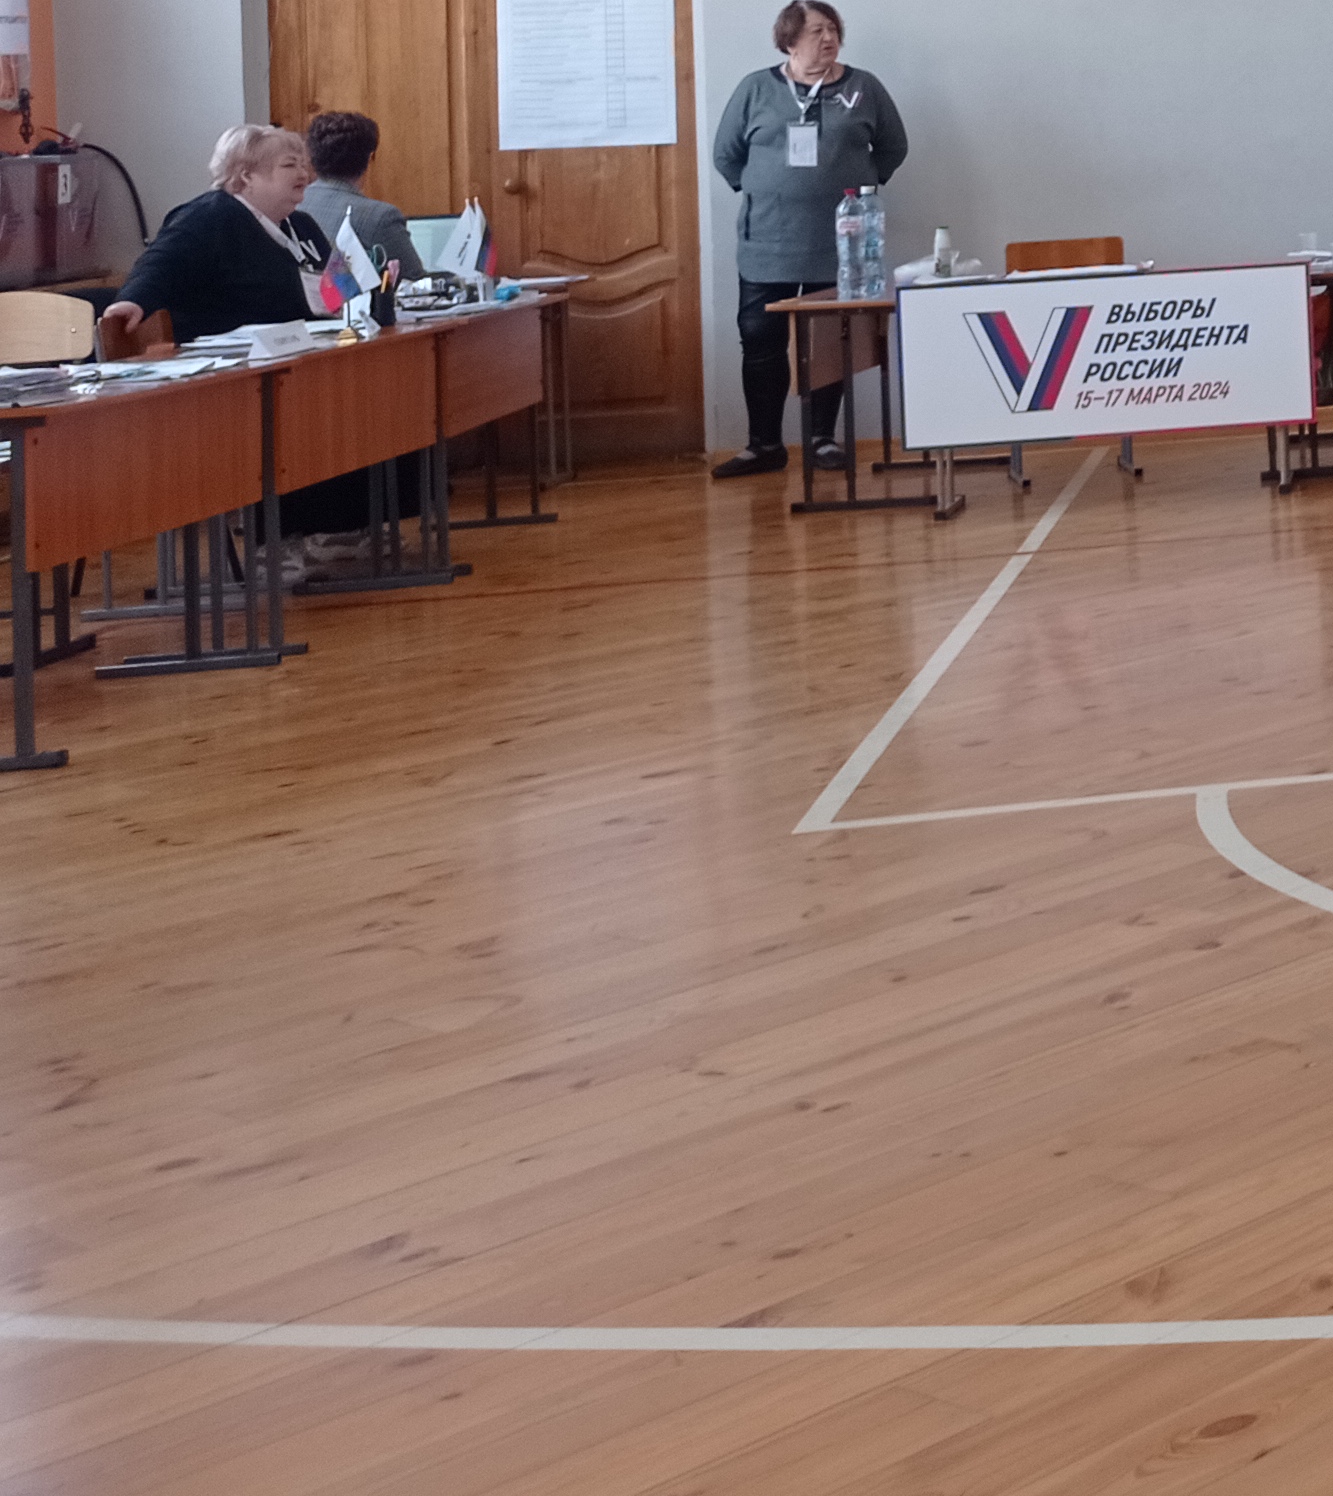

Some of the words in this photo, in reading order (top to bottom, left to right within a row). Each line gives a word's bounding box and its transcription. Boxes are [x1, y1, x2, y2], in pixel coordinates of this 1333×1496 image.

[1105, 297, 1217, 325] ВЫБОРЫ
[1094, 323, 1251, 355] ПРЕЗИДЕНТА
[1082, 356, 1185, 384] РОССИИ
[1073, 388, 1122, 411] 15–17
[1124, 383, 1185, 407] МАРТА
[1187, 381, 1232, 402] 2024
